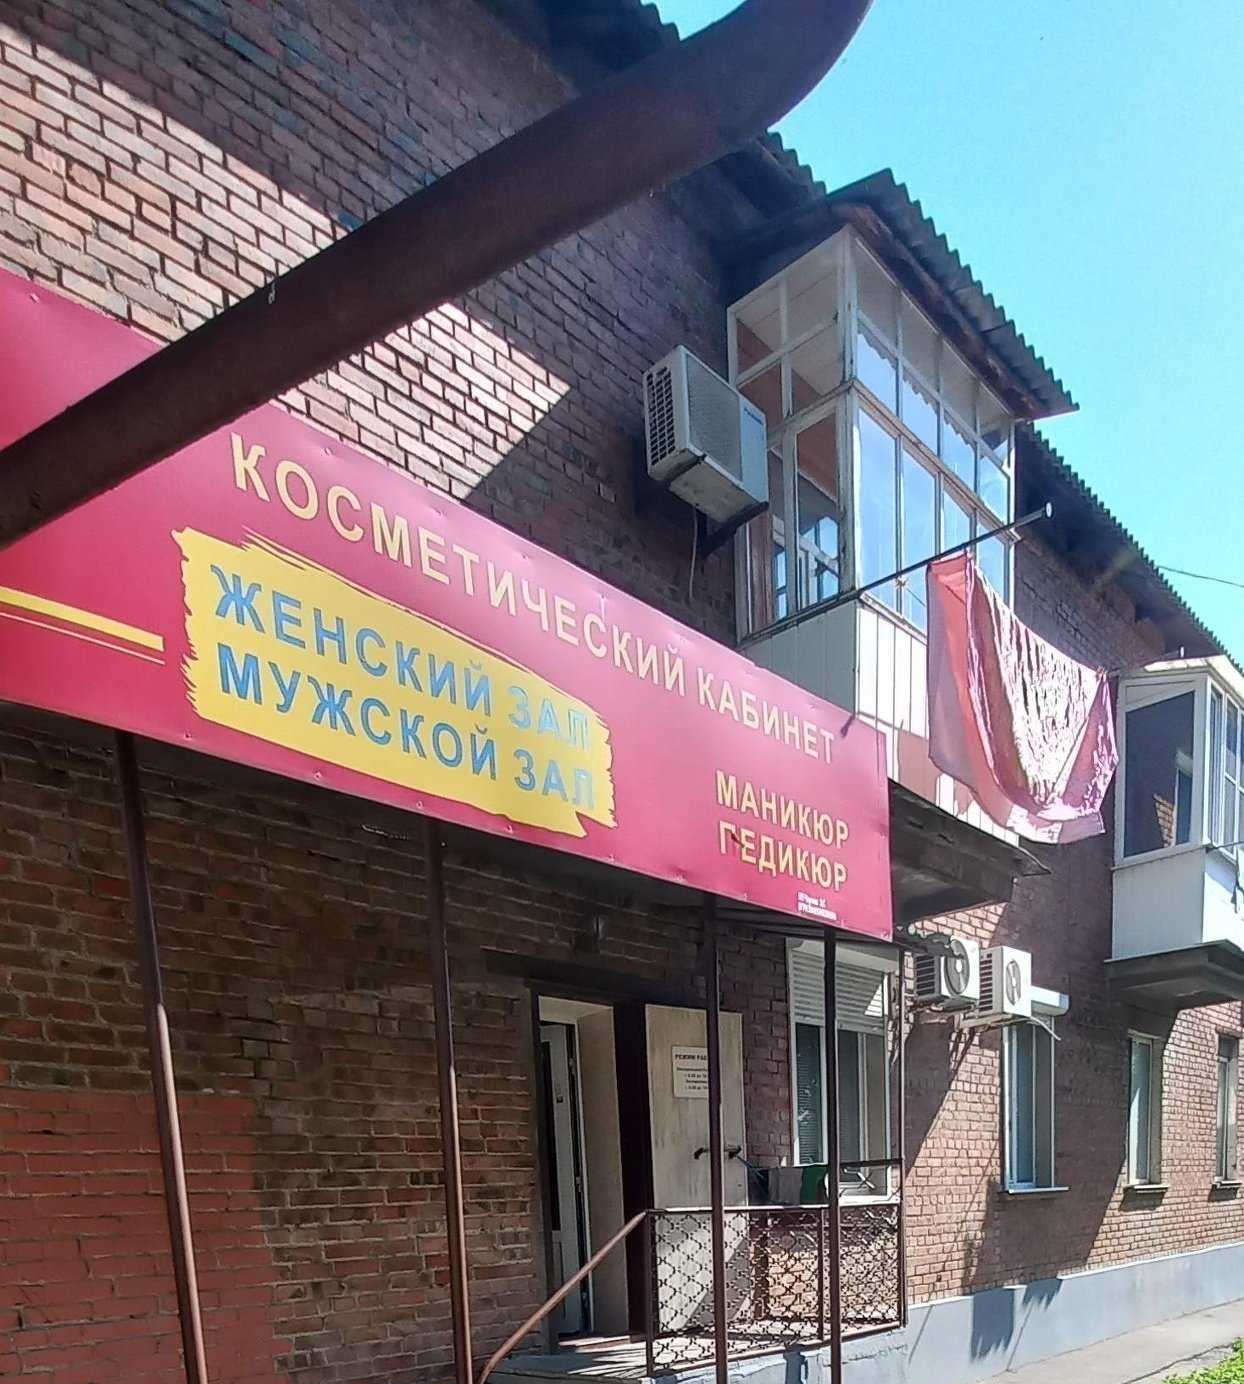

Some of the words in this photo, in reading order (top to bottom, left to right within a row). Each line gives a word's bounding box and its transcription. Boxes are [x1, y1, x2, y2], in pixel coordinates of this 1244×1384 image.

[210, 564, 491, 717] ЖЕНСКИЙ
[508, 685, 590, 752] ЗАЛ
[231, 431, 686, 697] КОСМЕТИЧЕСКИЙ
[697, 667, 835, 764] КАБИНЕТ
[217, 642, 497, 780] МУЖСКОЙ
[513, 748, 594, 810] ЗАЛ
[716, 770, 849, 849] МАНИКЮР
